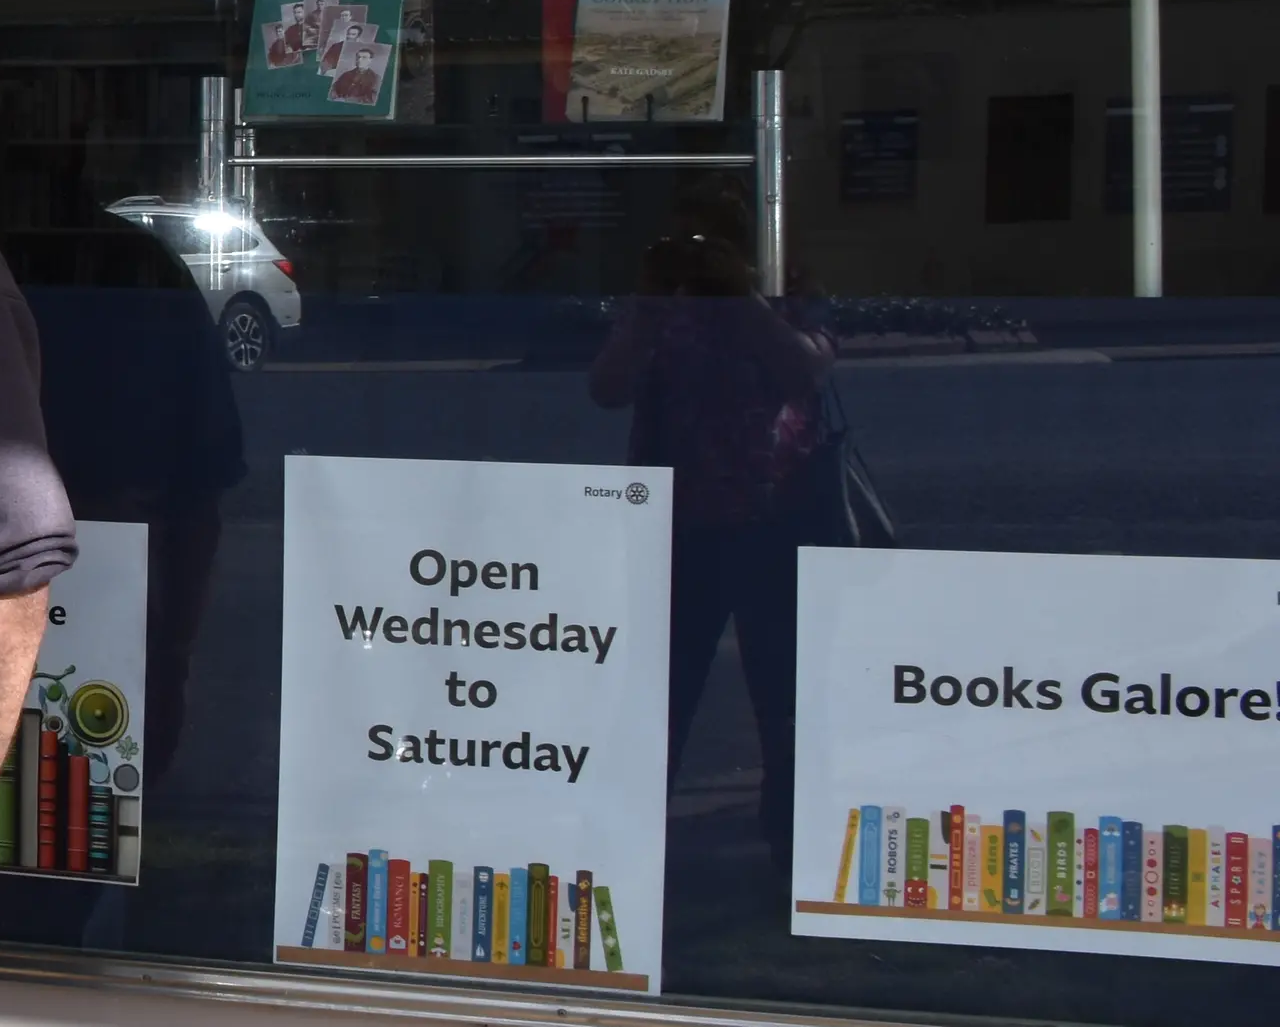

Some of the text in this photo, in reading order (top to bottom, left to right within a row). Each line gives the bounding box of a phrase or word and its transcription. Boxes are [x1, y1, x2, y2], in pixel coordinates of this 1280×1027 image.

[584, 486, 623, 500] Rotary
[409, 549, 539, 597] Open
[334, 604, 617, 665] Wednesday
[444, 671, 498, 709] to
[894, 664, 1063, 711] Books
[367, 724, 590, 784] Saturday
[887, 829, 899, 874] ROBOTS
[1008, 841, 1020, 879] PIRATES
[1056, 840, 1067, 879] BIRDS
[1209, 841, 1221, 909] ALPHABET
[351, 881, 362, 920] FANTASY
[392, 874, 406, 929] ROMANCE
[434, 873, 446, 928] BIOGRAPHY
[577, 896, 588, 943] detective
